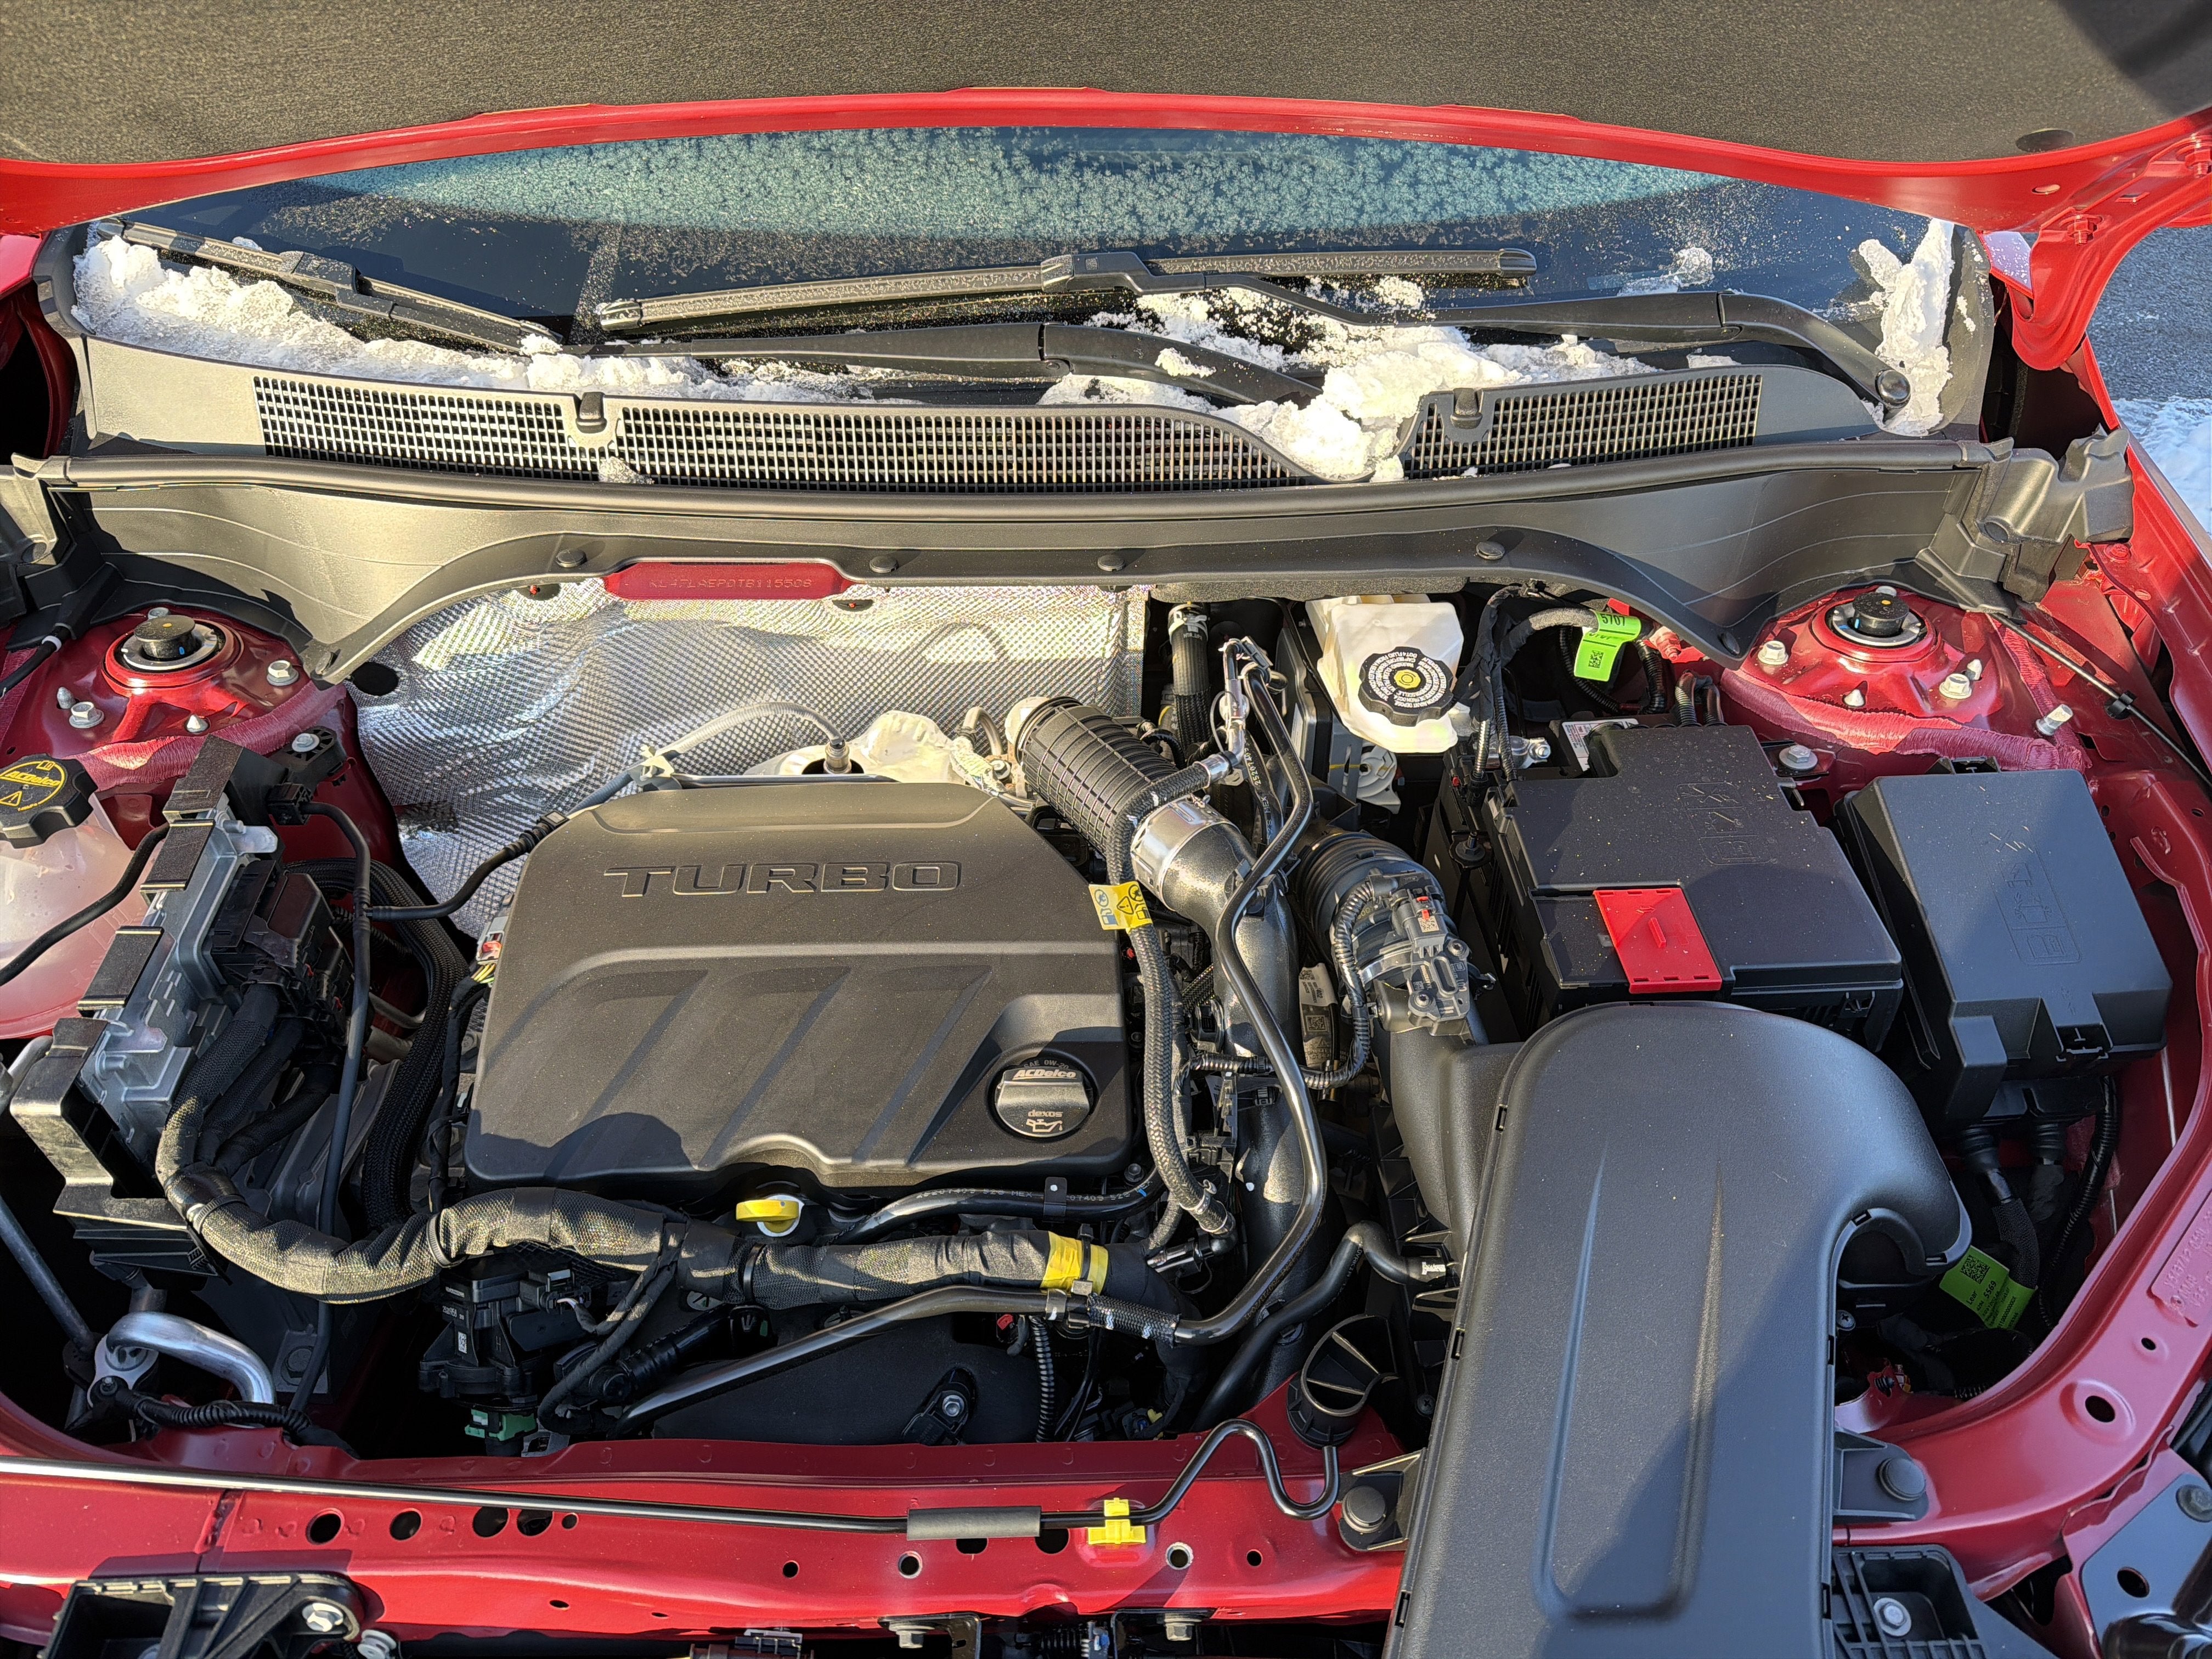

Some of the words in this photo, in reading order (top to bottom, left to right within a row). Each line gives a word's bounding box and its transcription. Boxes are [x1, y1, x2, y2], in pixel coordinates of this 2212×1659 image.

[649, 578, 812, 589] KL47LAEP0TB115508
[1600, 613, 1626, 627] 5707
[5, 770, 61, 786] ACDelco
[1260, 795, 1271, 814] MEX
[603, 861, 962, 898] TURBO
[1023, 1059, 1040, 1068] SAE
[1043, 1059, 1069, 1069] 0W-20
[1014, 1069, 1076, 1078] ACDelco
[1028, 1109, 1063, 1118] dexos
[1011, 1189, 1032, 1198] MEX
[1983, 1280, 1997, 1299] 5569
[1966, 1290, 1978, 1305] Lear
